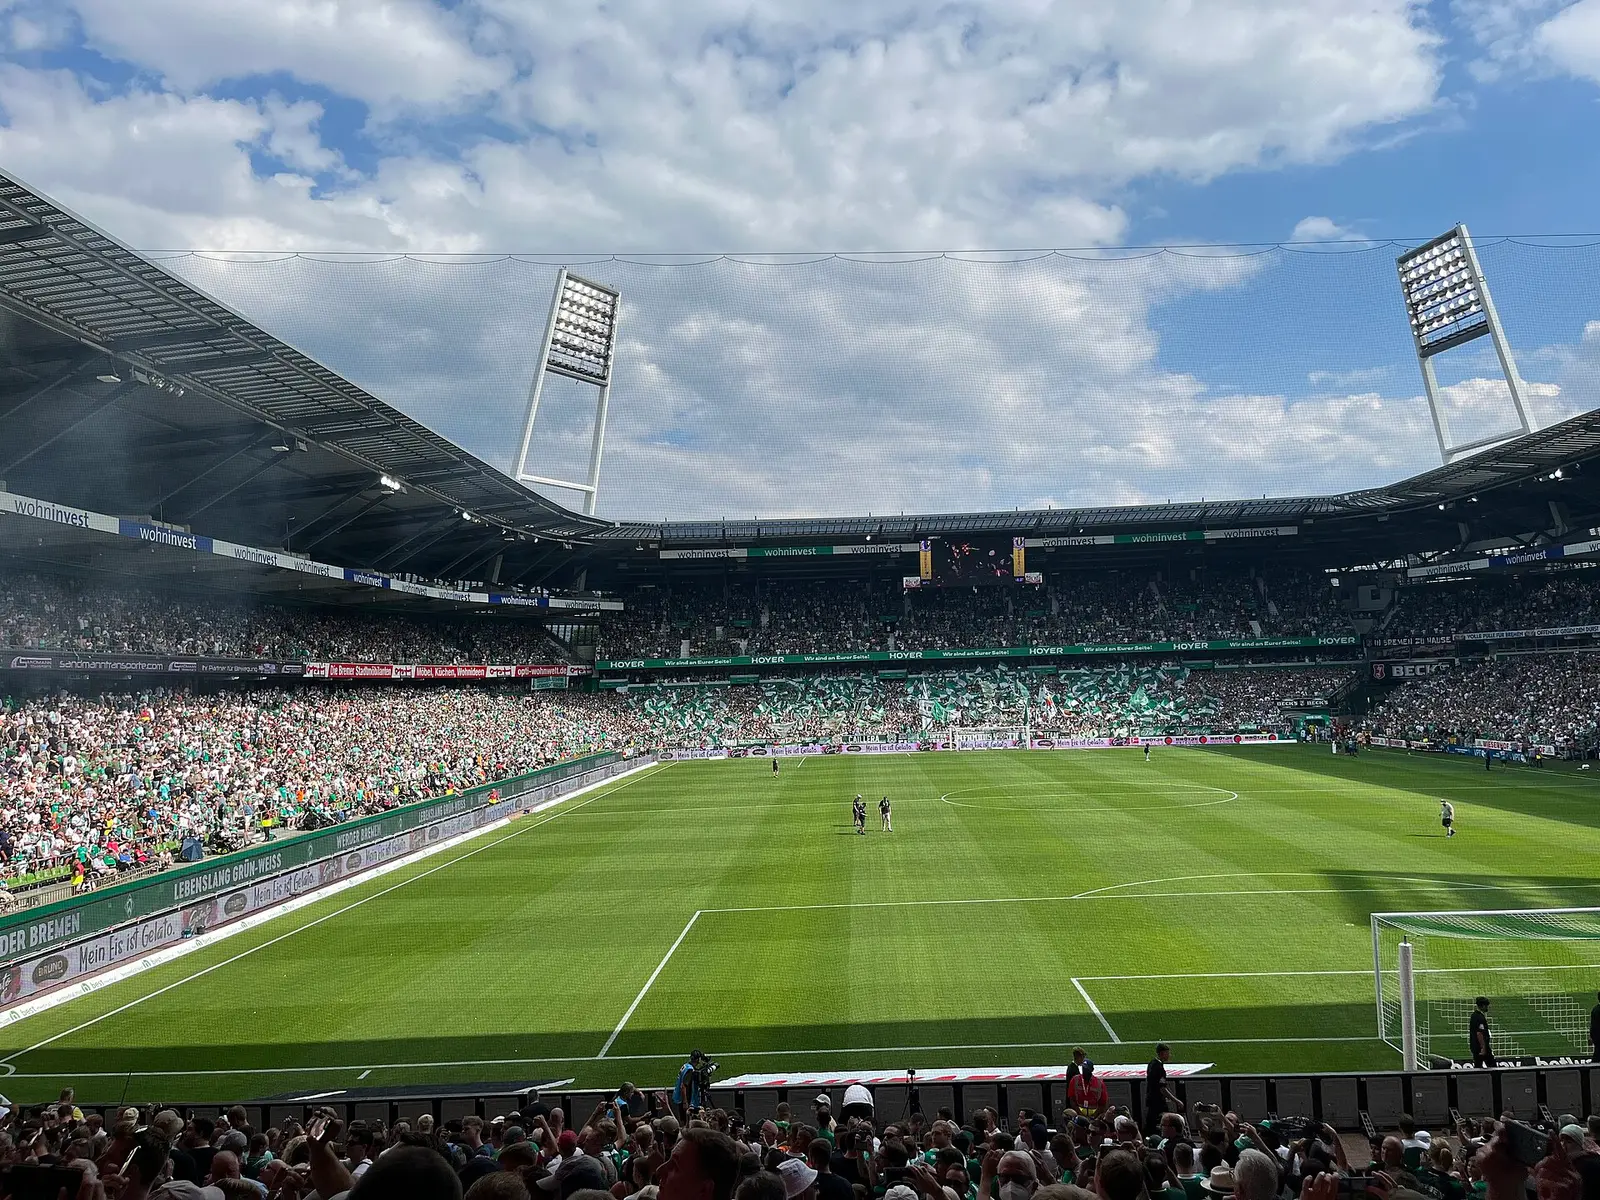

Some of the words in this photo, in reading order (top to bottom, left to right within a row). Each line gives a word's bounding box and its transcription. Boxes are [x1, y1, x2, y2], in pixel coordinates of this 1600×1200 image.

[15, 499, 89, 528] wohninvest
[140, 526, 196, 549] wohninvest
[1132, 532, 1187, 543] wohninvest
[1223, 527, 1279, 538] wohninvest
[1042, 537, 1096, 546] wohninvest
[677, 550, 729, 559] wohninvest
[765, 547, 816, 557] wohninvest
[850, 544, 902, 554] wohninvest
[234, 547, 277, 566] wohninvest
[1506, 549, 1546, 565] wohninvest
[293, 560, 330, 577] wohninvest
[1426, 562, 1471, 575] wohninvest
[353, 572, 383, 588] wohninvest
[500, 595, 538, 606] wohninvest
[565, 600, 600, 610] wohninvest
[1173, 642, 1208, 650] HOYER
[1319, 637, 1356, 645] HOYER
[1030, 647, 1064, 655] HOYER
[60, 659, 164, 671] sandmanntransporte.com
[610, 660, 645, 668] HOYER
[752, 656, 785, 664] HOYER
[330, 664, 338, 676] Die
[338, 664, 355, 676] Bremer
[434, 666, 456, 678] Küchen,
[848, 735, 880, 743] CAILLERA
[336, 829, 359, 849] WERDER
[360, 823, 381, 841] BREMEN
[174, 868, 231, 900] LEBENSLANG
[232, 853, 282, 882] GRÜN-WEISS
[254, 886, 271, 907] Mein
[273, 880, 282, 900] Eis
[283, 876, 292, 893] ist
[0, 929, 26, 956] DER
[29, 912, 80, 947] BREMEN
[79, 946, 105, 972] Mein
[109, 935, 123, 961] Eis
[126, 927, 139, 951] ist
[142, 918, 175, 948] Gelato.
[38, 960, 64, 977] BRUNO
